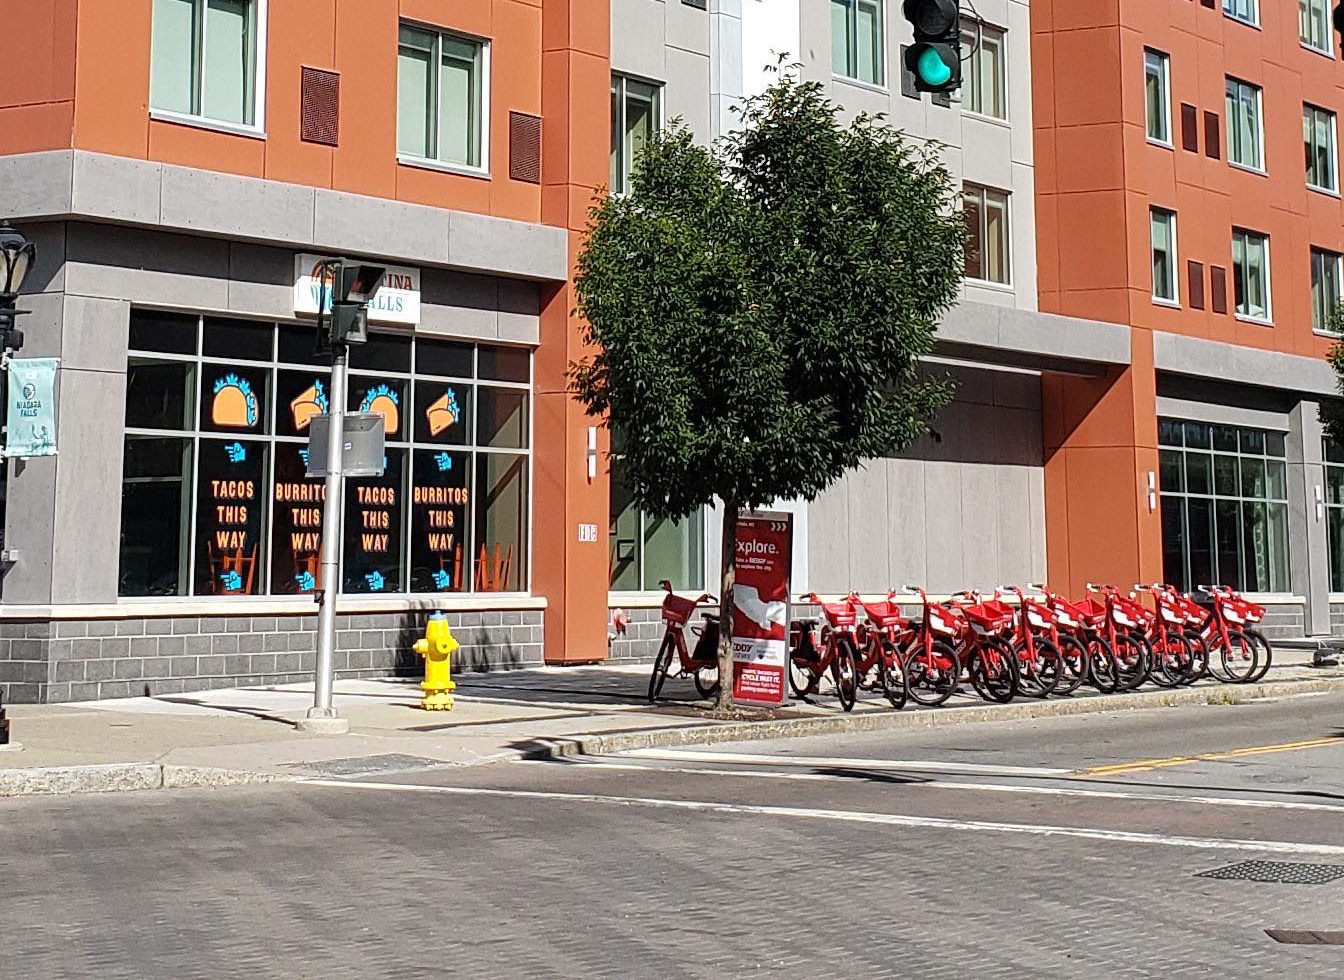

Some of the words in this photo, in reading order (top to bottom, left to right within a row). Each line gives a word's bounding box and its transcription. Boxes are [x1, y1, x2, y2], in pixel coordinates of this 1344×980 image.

[367, 295, 403, 312] ALLS
[16, 401, 42, 409] NIAGARA
[20, 409, 38, 417] FALLS
[211, 480, 254, 498] TACOS
[276, 482, 326, 500] BURRITO
[357, 486, 395, 503] TACOS
[414, 486, 468, 503] BURRITOS
[217, 506, 247, 523] THIS
[292, 508, 320, 525] THIS
[362, 510, 389, 527] THIS
[428, 510, 454, 527] THIS
[216, 531, 246, 549] WAY
[291, 533, 319, 550] WAY
[361, 533, 388, 551] WAY
[428, 533, 453, 550] WAY
